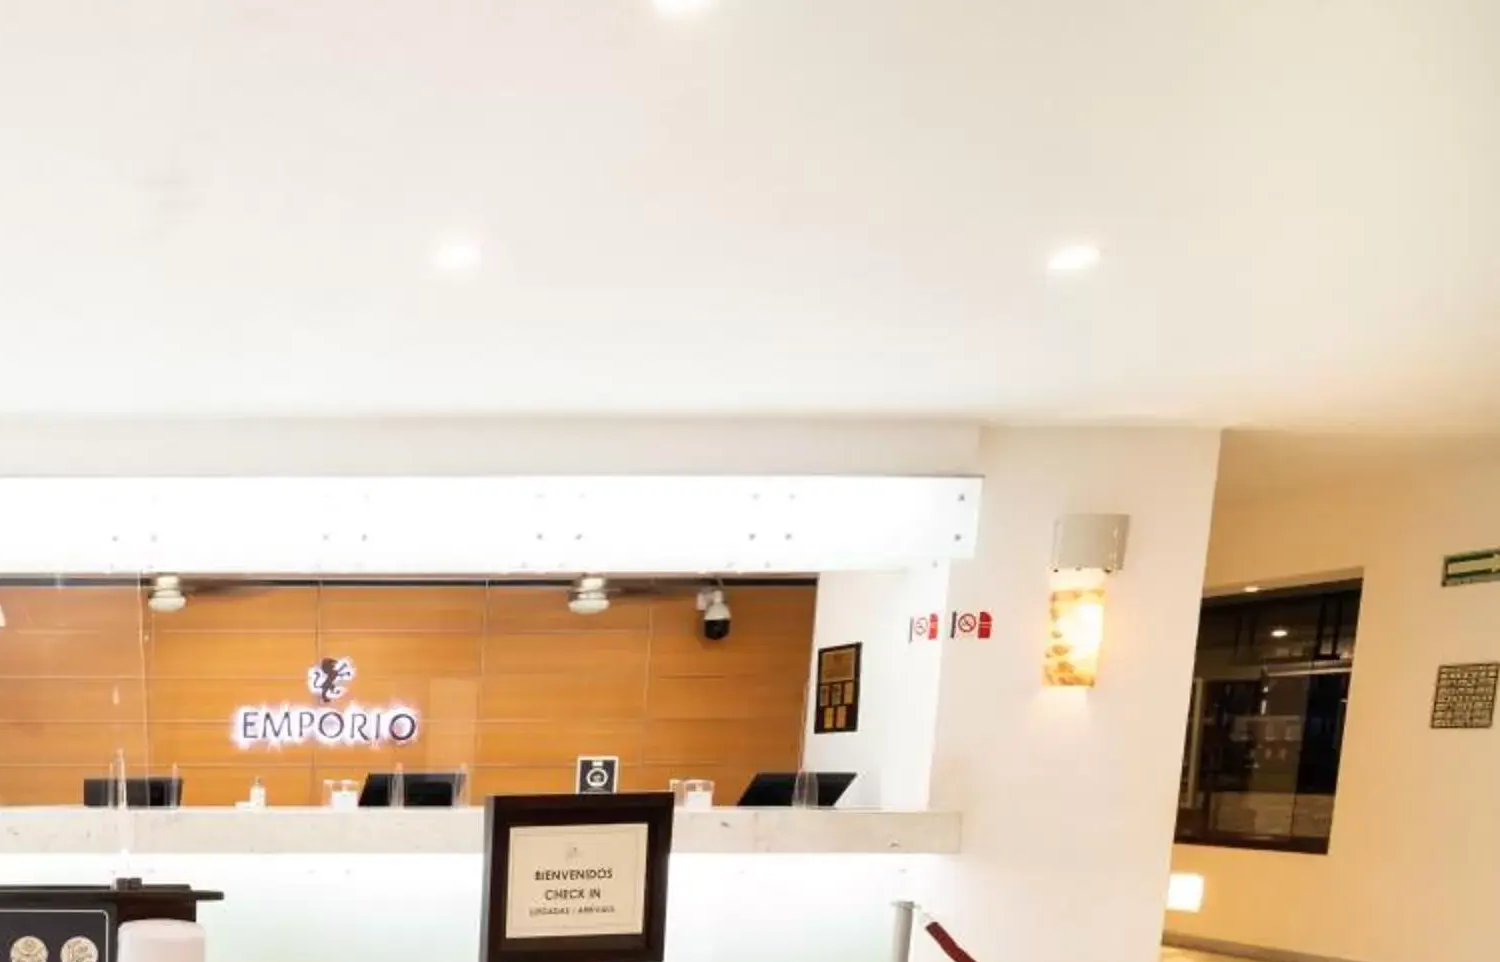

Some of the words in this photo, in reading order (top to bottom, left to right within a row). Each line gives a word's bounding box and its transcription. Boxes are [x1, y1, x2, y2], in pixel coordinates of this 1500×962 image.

[243, 711, 416, 741] EMPORIO
[534, 868, 613, 881] BIENVENIDOS
[544, 888, 585, 901] CHECK
[589, 888, 601, 899] IN
